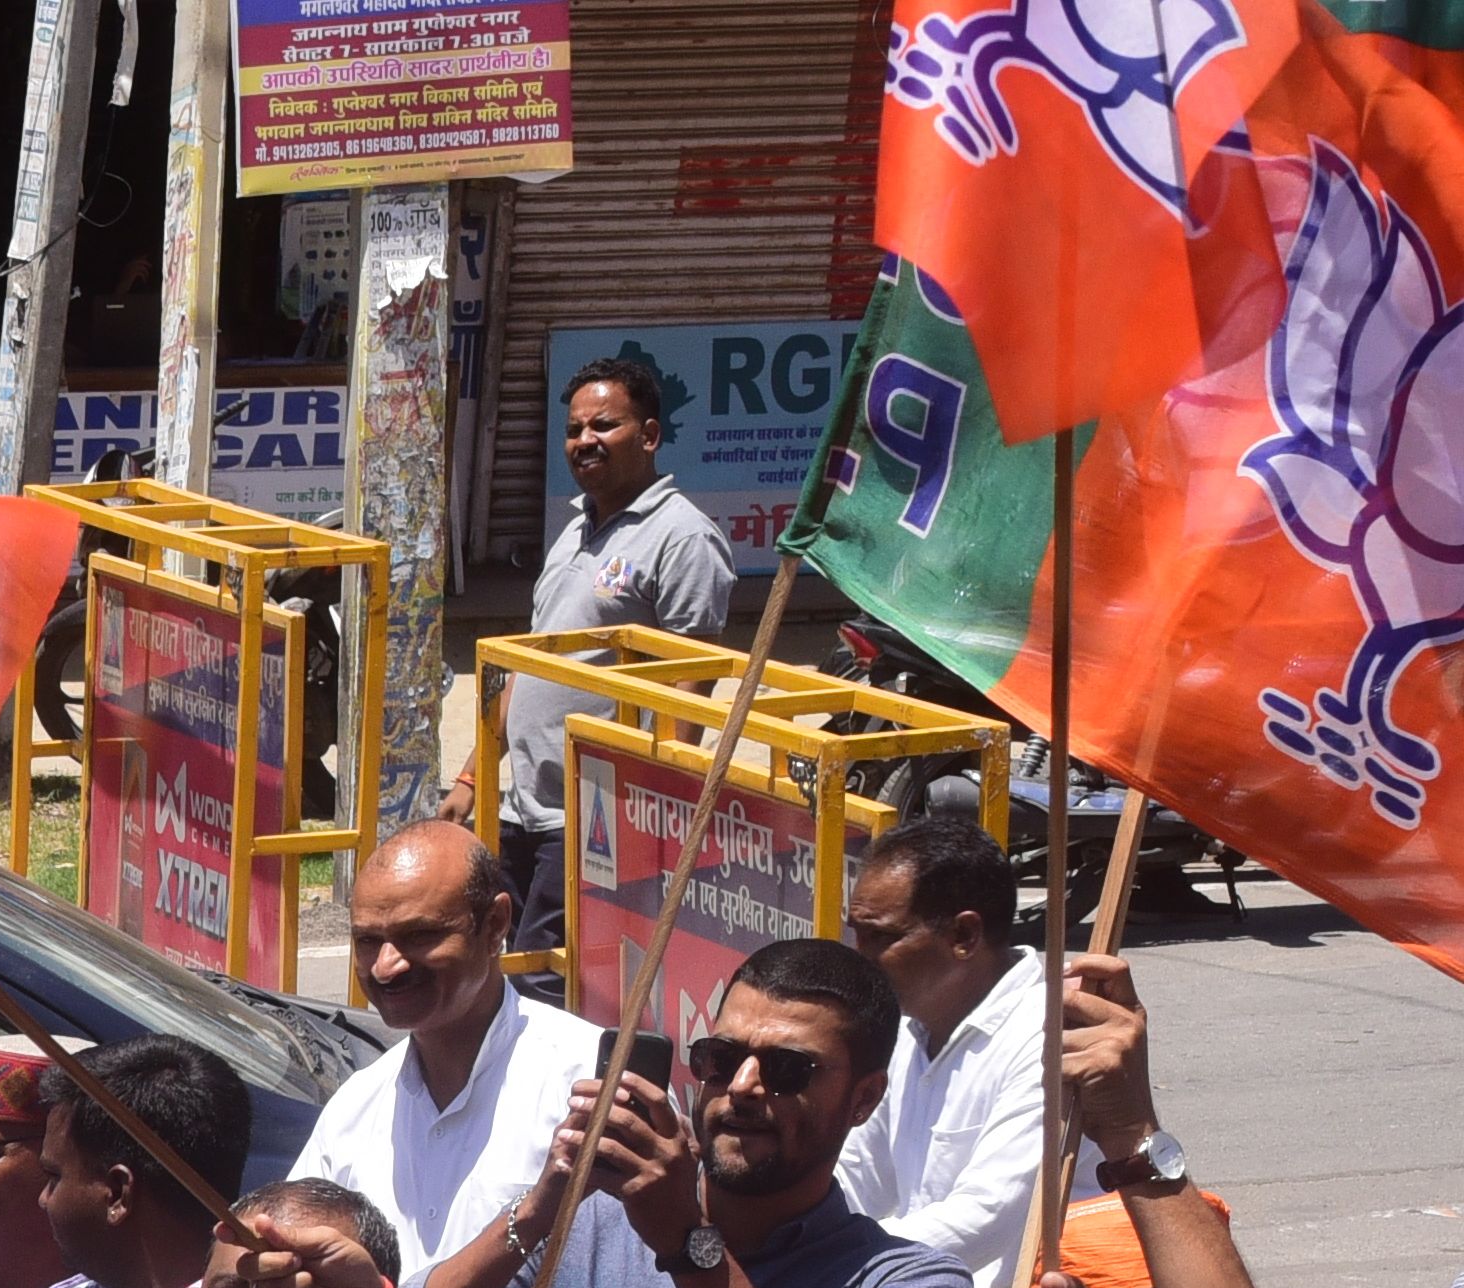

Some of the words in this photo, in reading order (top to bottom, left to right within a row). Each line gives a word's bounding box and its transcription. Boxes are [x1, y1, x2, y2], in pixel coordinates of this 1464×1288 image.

[481, 10, 520, 27] नगर
[449, 34, 495, 48] 7.30
[262, 65, 321, 90] आपकी
[408, 58, 454, 79] सादर
[389, 90, 419, 108] नगर
[473, 79, 519, 100] समिति
[255, 123, 306, 141] भगवान
[513, 98, 558, 120] समिति
[189, 789, 234, 834] WOND
[624, 782, 707, 854] याताया
[191, 832, 231, 858] CEME
[154, 847, 228, 946] XTREM
[700, 877, 718, 918] एवं
[720, 884, 765, 936] सुरक्षित
